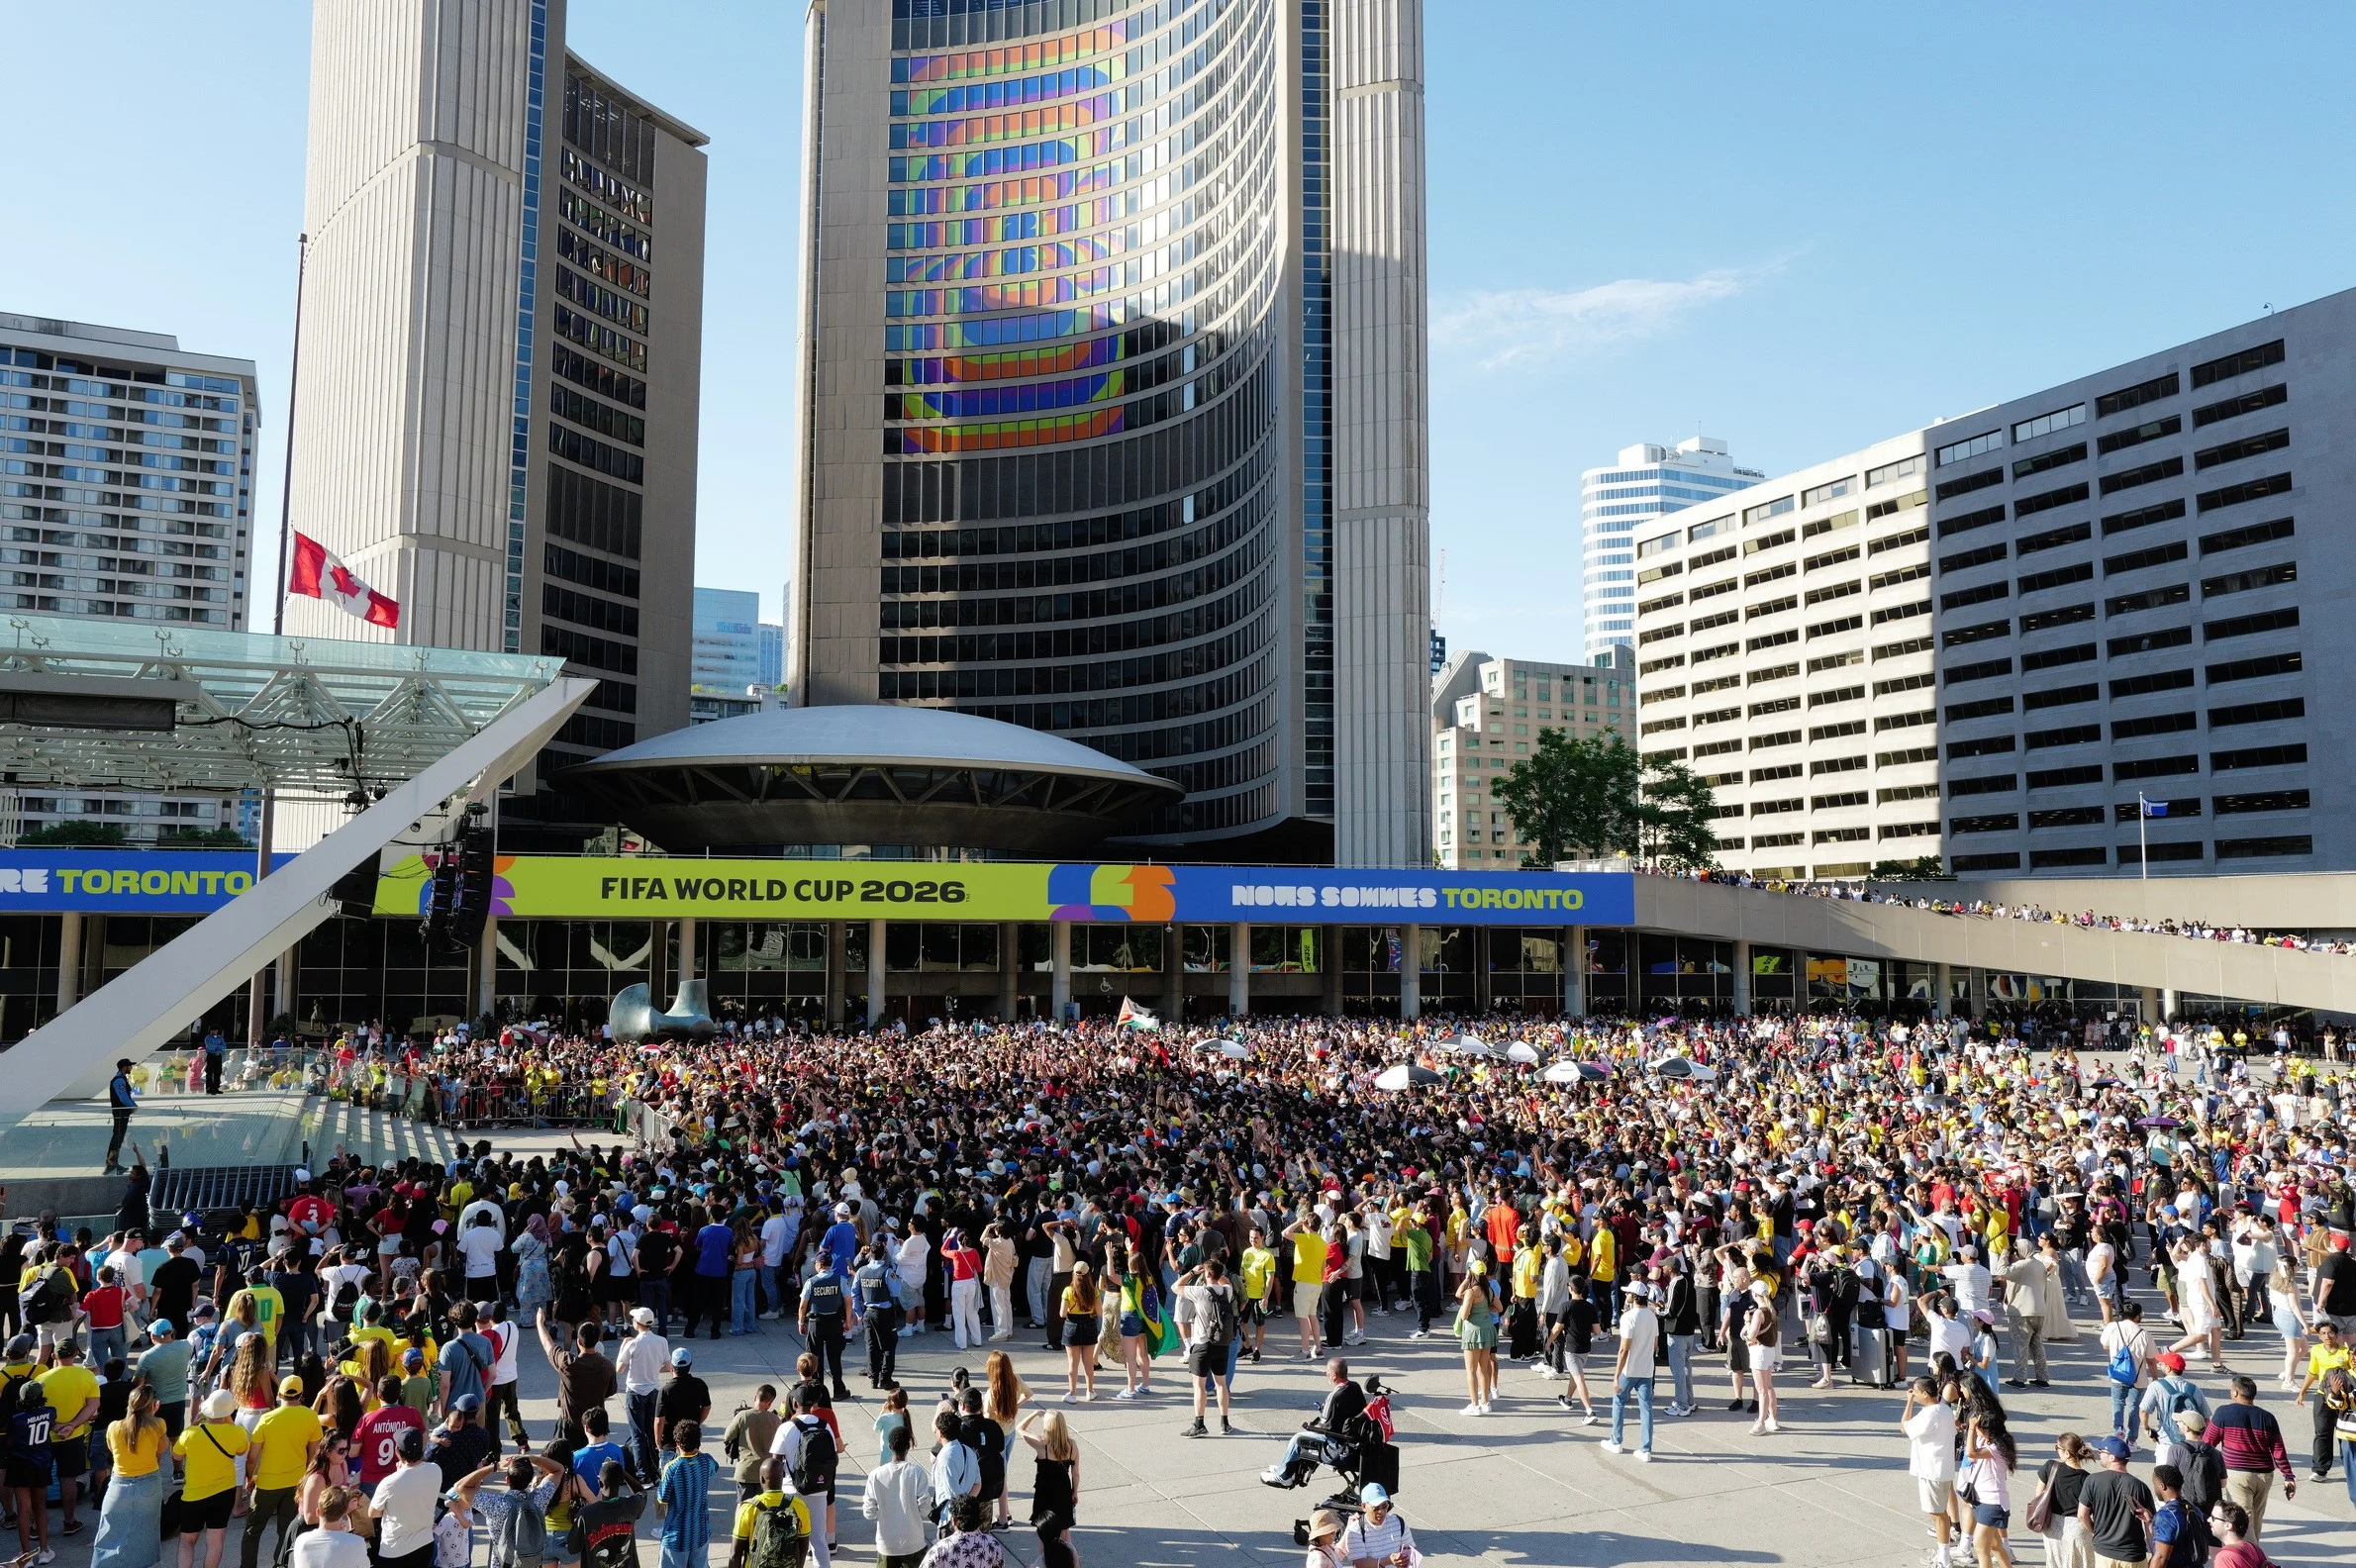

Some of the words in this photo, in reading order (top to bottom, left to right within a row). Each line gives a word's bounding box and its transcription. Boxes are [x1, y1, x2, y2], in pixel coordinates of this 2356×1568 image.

[56, 869, 252, 895] TORONTO
[601, 877, 668, 900] FIFA
[673, 878, 788, 902] WORLD
[793, 879, 854, 903] CUP
[860, 880, 966, 904] 2026
[1232, 885, 1316, 906] NOUS
[1321, 887, 1437, 908] SOMMES
[1442, 888, 1584, 910] TORONTO
[813, 1285, 839, 1297] SECURITY
[861, 1278, 883, 1288] SECURITY
[28, 1420, 50, 1446] 10
[377, 1437, 395, 1466] 9
